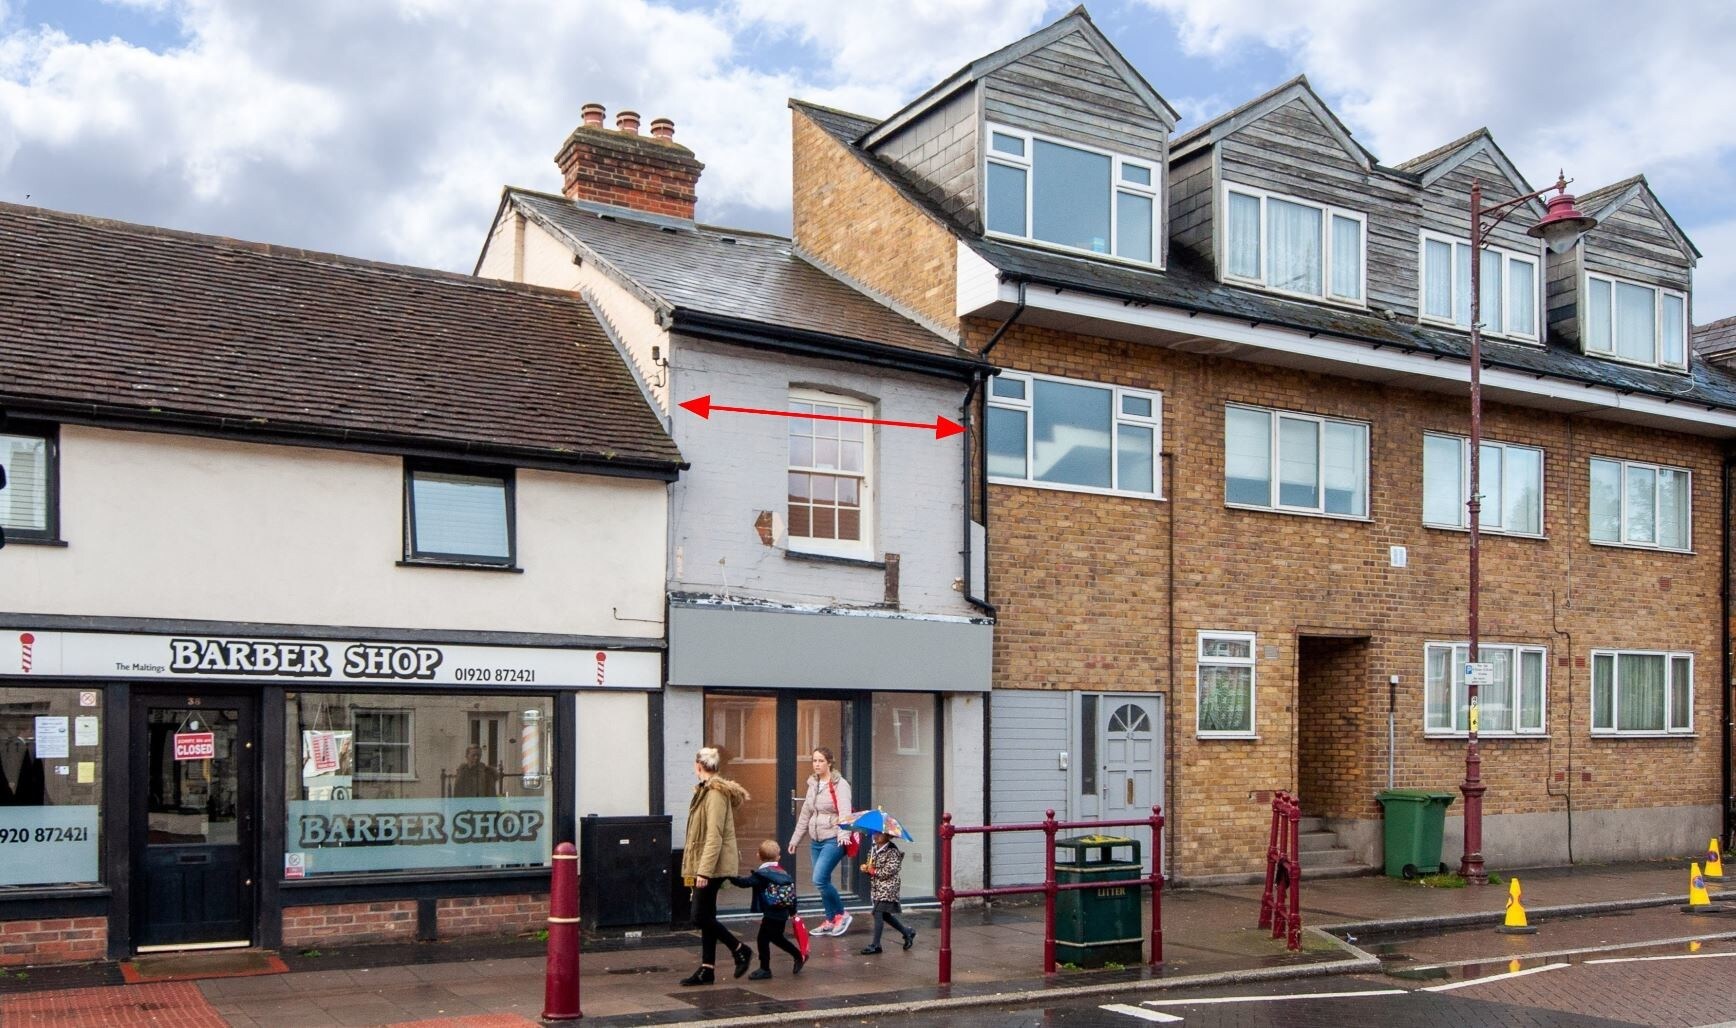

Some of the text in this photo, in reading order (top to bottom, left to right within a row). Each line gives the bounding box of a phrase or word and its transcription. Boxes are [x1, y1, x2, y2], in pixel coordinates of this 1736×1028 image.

[170, 638, 443, 680] BARBER SHOP
[116, 662, 165, 674] The Maltings
[455, 667, 535, 682] 01920 872421
[177, 744, 212, 755] CLOSED
[34, 827, 88, 842] 872421
[300, 809, 544, 848] BARBER SHOP
[1097, 887, 1126, 897] LITTER
